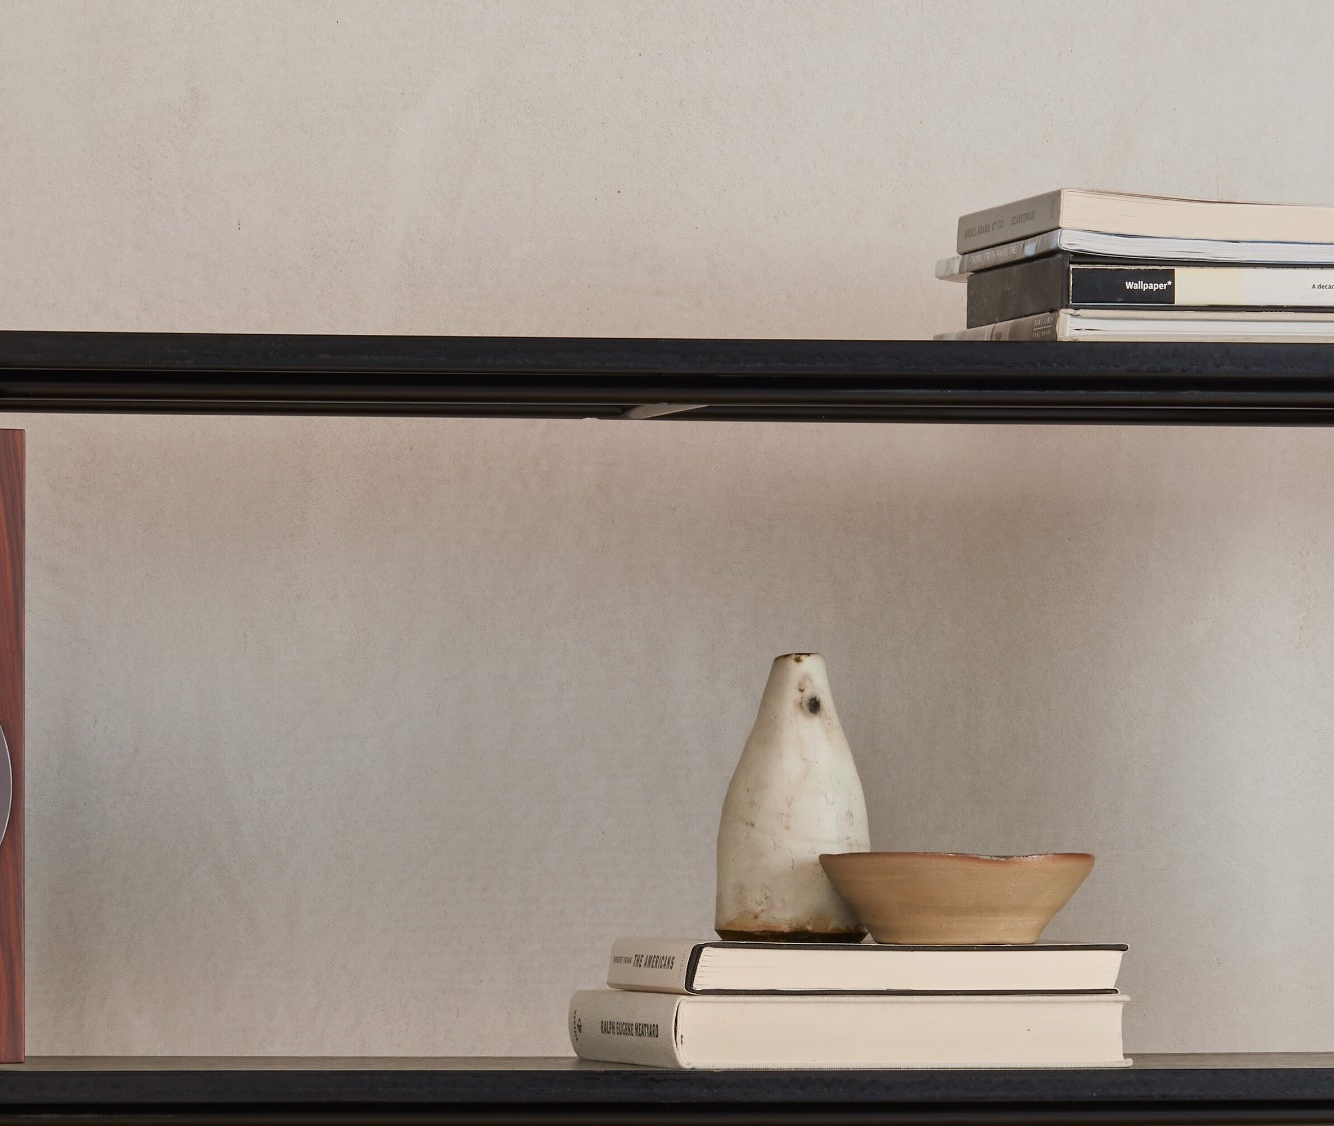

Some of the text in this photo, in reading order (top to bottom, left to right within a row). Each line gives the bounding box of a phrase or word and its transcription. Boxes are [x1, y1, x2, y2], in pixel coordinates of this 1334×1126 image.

[633, 954, 644, 968] THE
[644, 954, 675, 970] AMERICANS
[600, 1020, 616, 1035] RALPH
